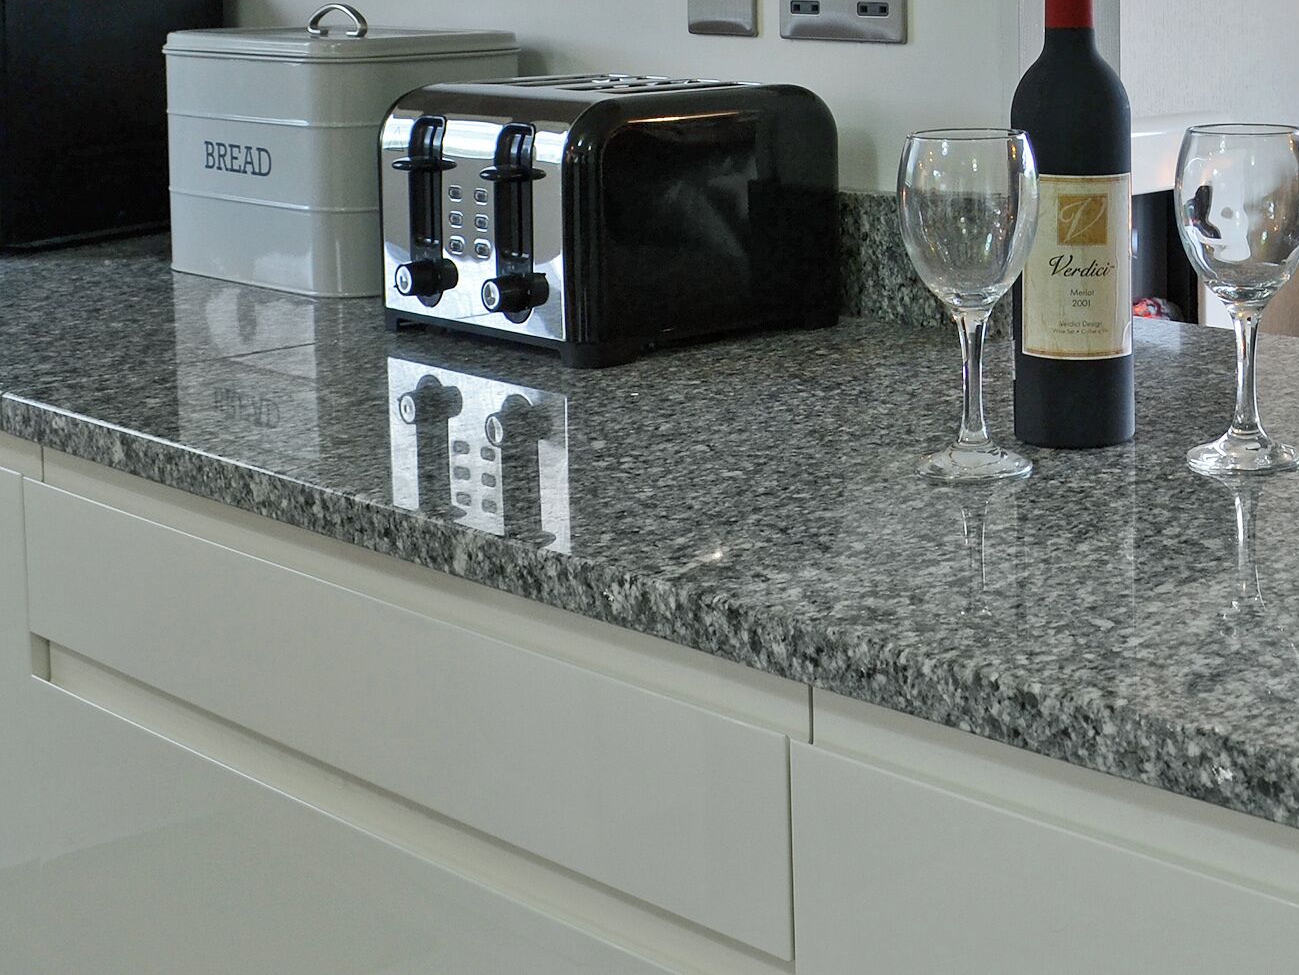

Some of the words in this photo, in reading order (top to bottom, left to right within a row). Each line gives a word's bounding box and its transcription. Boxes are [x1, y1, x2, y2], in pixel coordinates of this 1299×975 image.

[204, 140, 272, 177] BREAD
[1059, 197, 1106, 243] V
[1049, 254, 1111, 277] Verdici
[1070, 289, 1095, 297] Merlot
[1072, 299, 1091, 307] 2001
